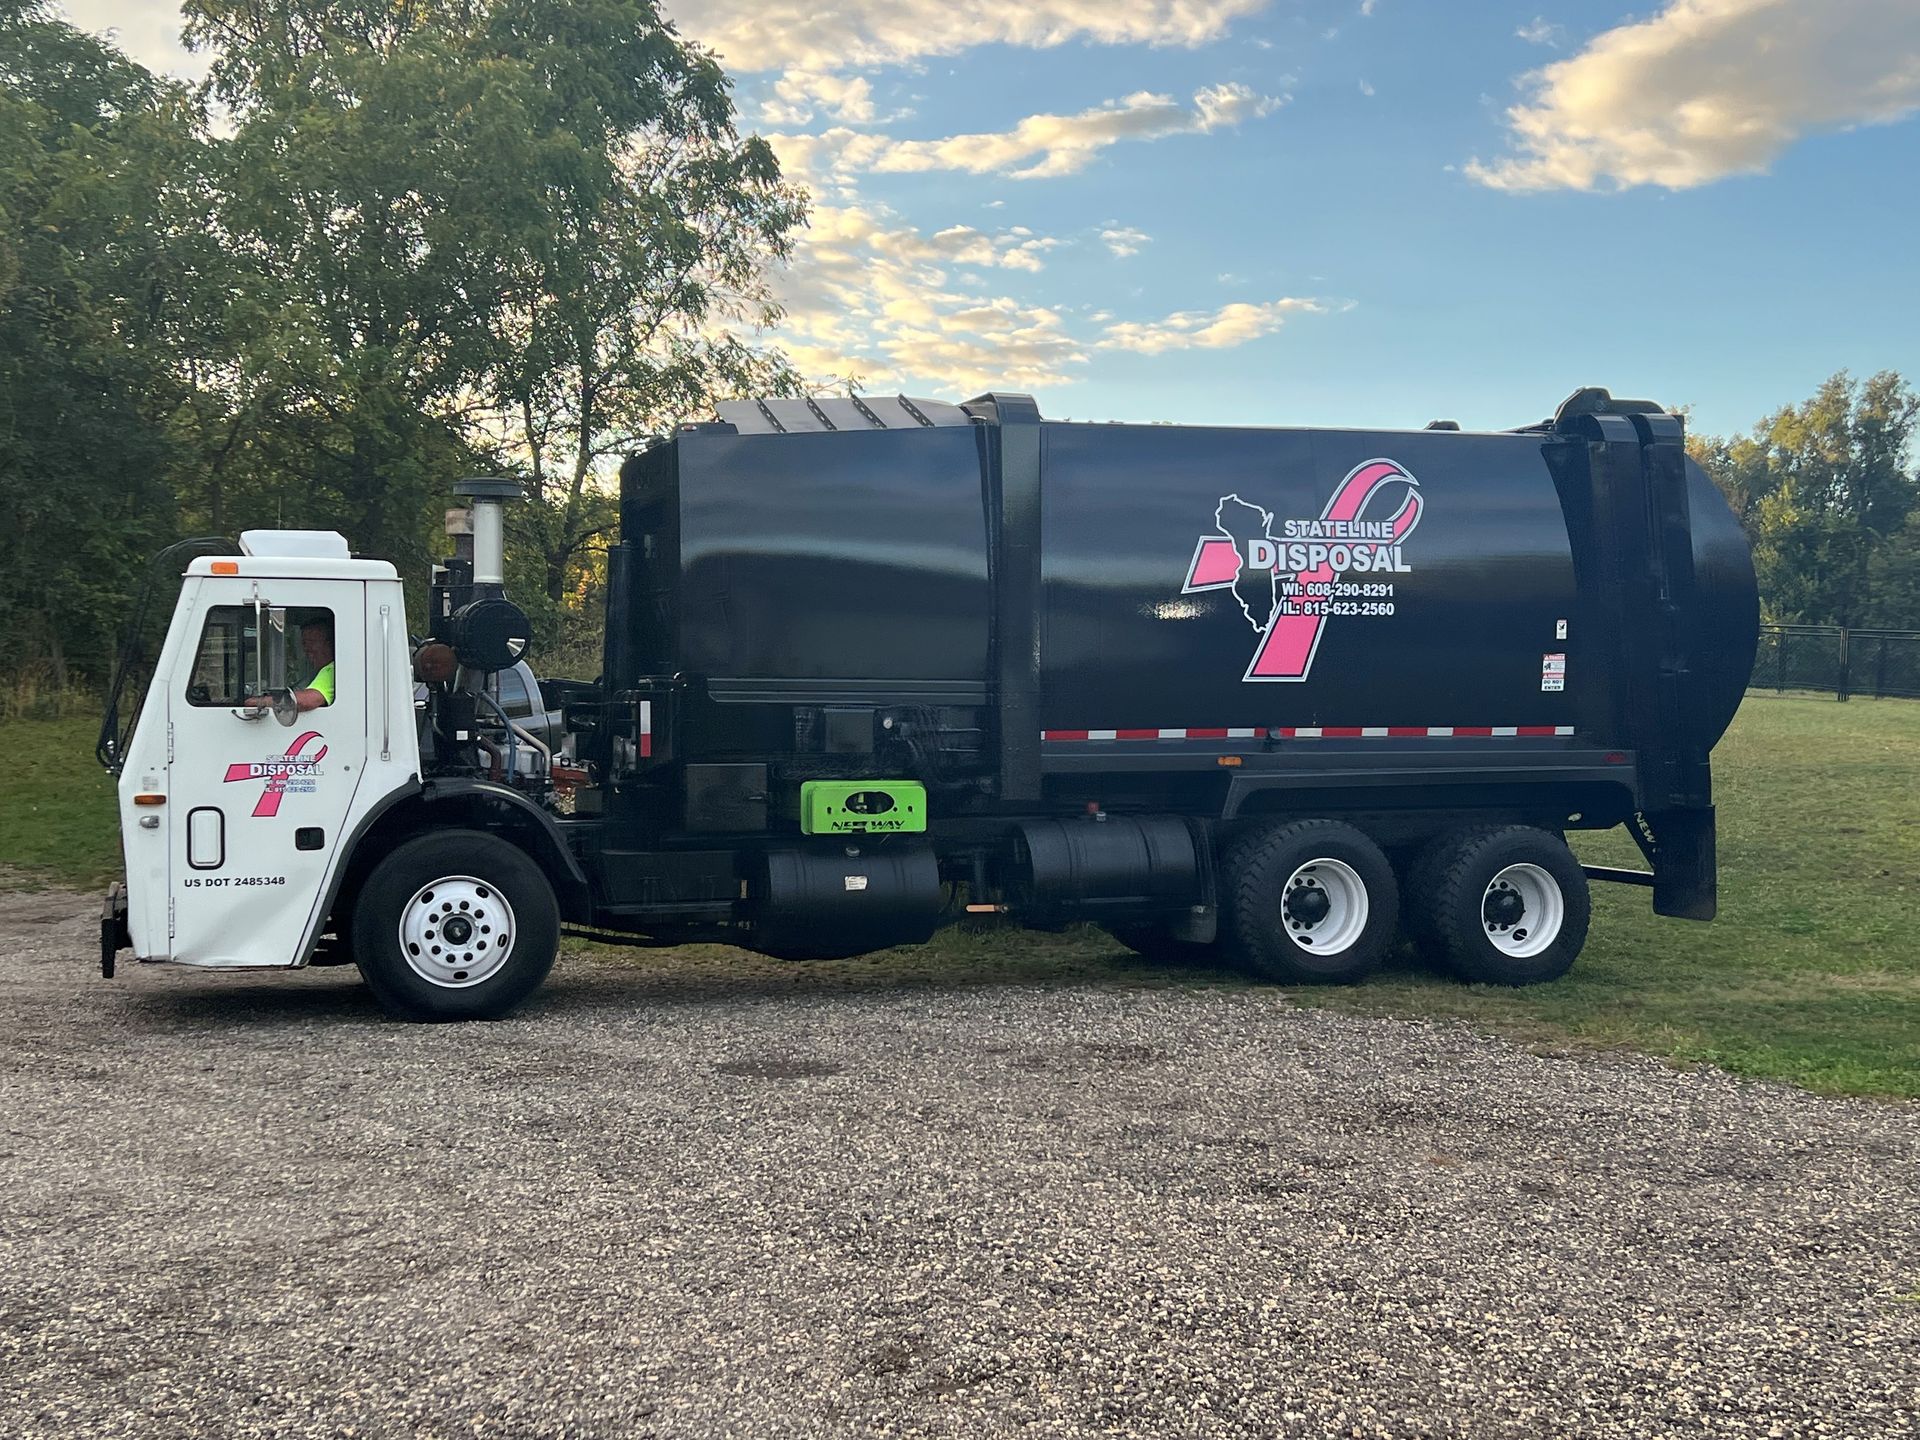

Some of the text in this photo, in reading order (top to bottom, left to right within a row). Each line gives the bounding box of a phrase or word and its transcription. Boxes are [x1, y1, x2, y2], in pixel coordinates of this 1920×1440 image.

[1284, 520, 1394, 538] STATELINE
[1248, 539, 1412, 573] DISPOSAL
[1282, 583, 1394, 597] WI: 608-290-8291
[1283, 602, 1395, 616] IL: 815-623-2560
[249, 764, 325, 777] DISPOSAL
[871, 820, 905, 830] WAY
[184, 876, 285, 888] US DOT 2485348
